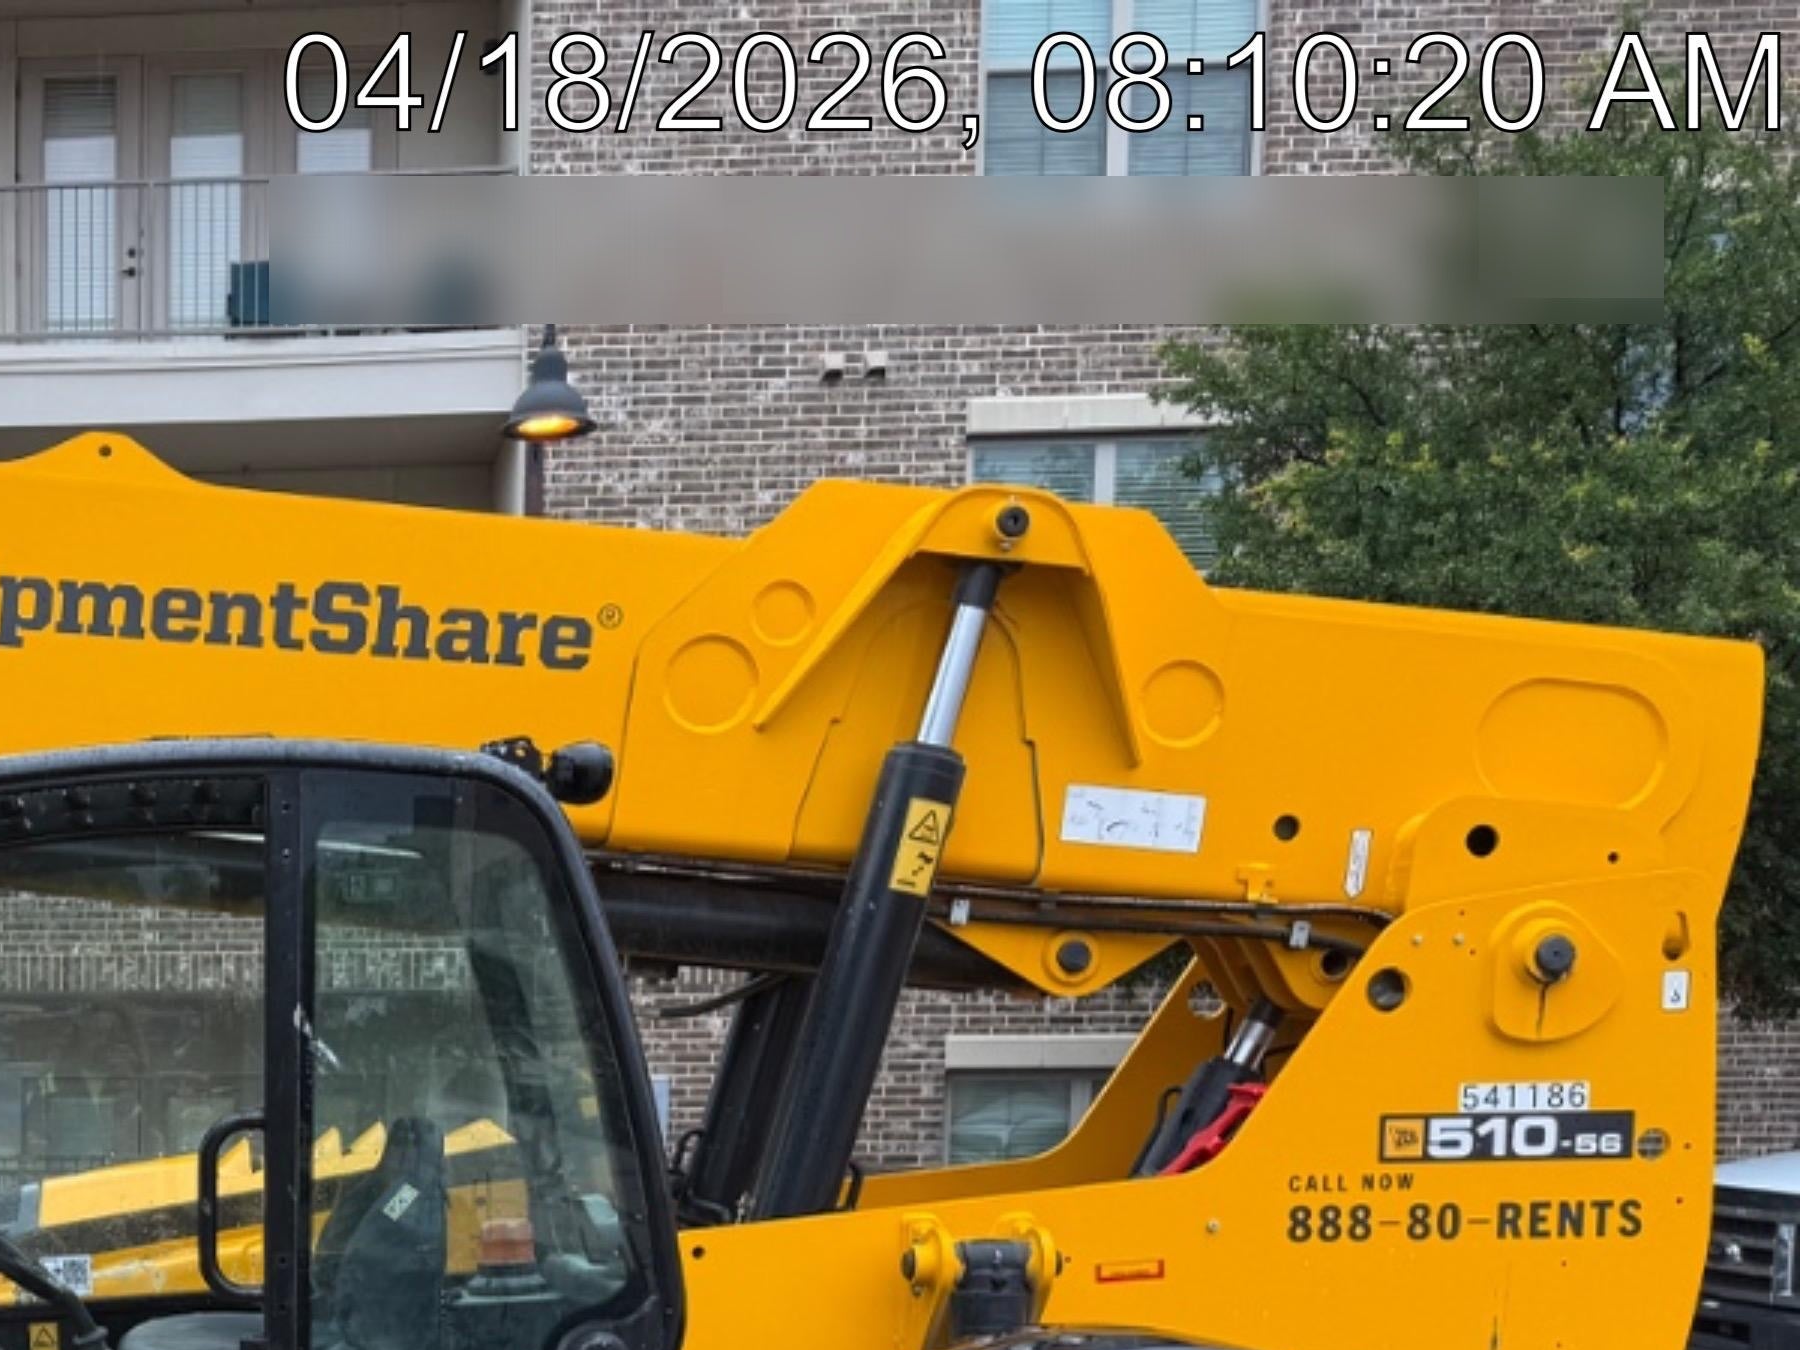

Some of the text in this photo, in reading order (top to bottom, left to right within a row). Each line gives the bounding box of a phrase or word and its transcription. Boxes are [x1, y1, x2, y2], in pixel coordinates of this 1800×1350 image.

[1462, 1082, 1586, 1111] 541186
[1288, 1173, 1415, 1193] CALL NOW
[1286, 1198, 1644, 1244] 888-80-RENTS
